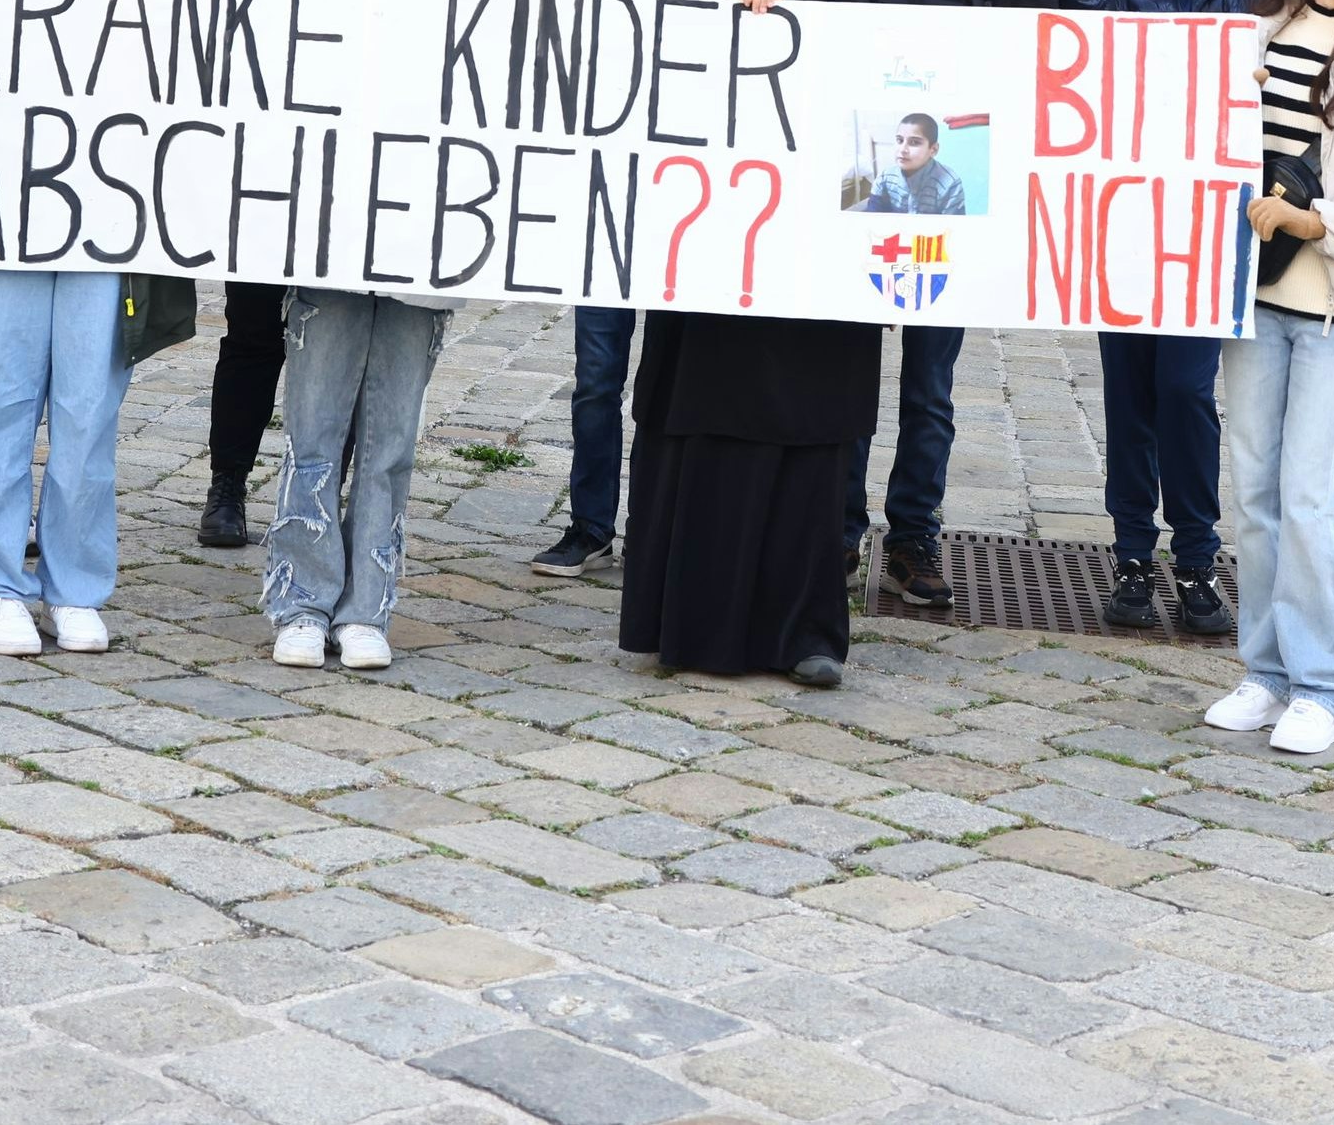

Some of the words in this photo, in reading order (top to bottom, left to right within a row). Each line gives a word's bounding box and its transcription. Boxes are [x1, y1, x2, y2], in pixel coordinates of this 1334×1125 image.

[1033, 12, 1264, 169] BITTE
[890, 263, 921, 272] FCB
[1026, 171, 1254, 339] NICHT!
